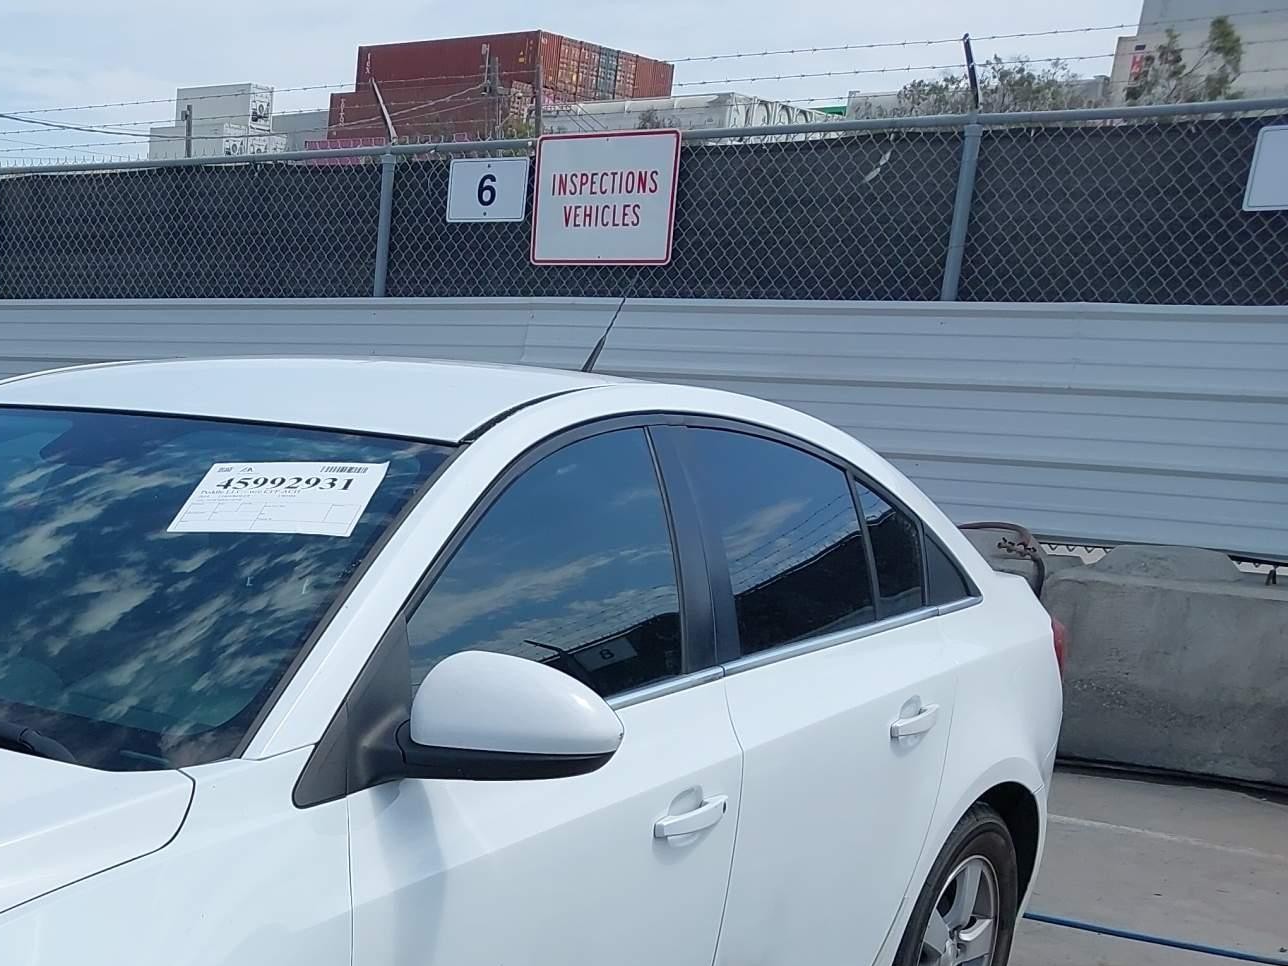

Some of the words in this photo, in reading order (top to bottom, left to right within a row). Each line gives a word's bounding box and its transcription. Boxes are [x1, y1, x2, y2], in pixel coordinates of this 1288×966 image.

[477, 174, 497, 206] 6
[551, 170, 659, 196] INSPECTIONS
[563, 204, 641, 227] VEHICLES
[216, 476, 355, 491] 45992931
